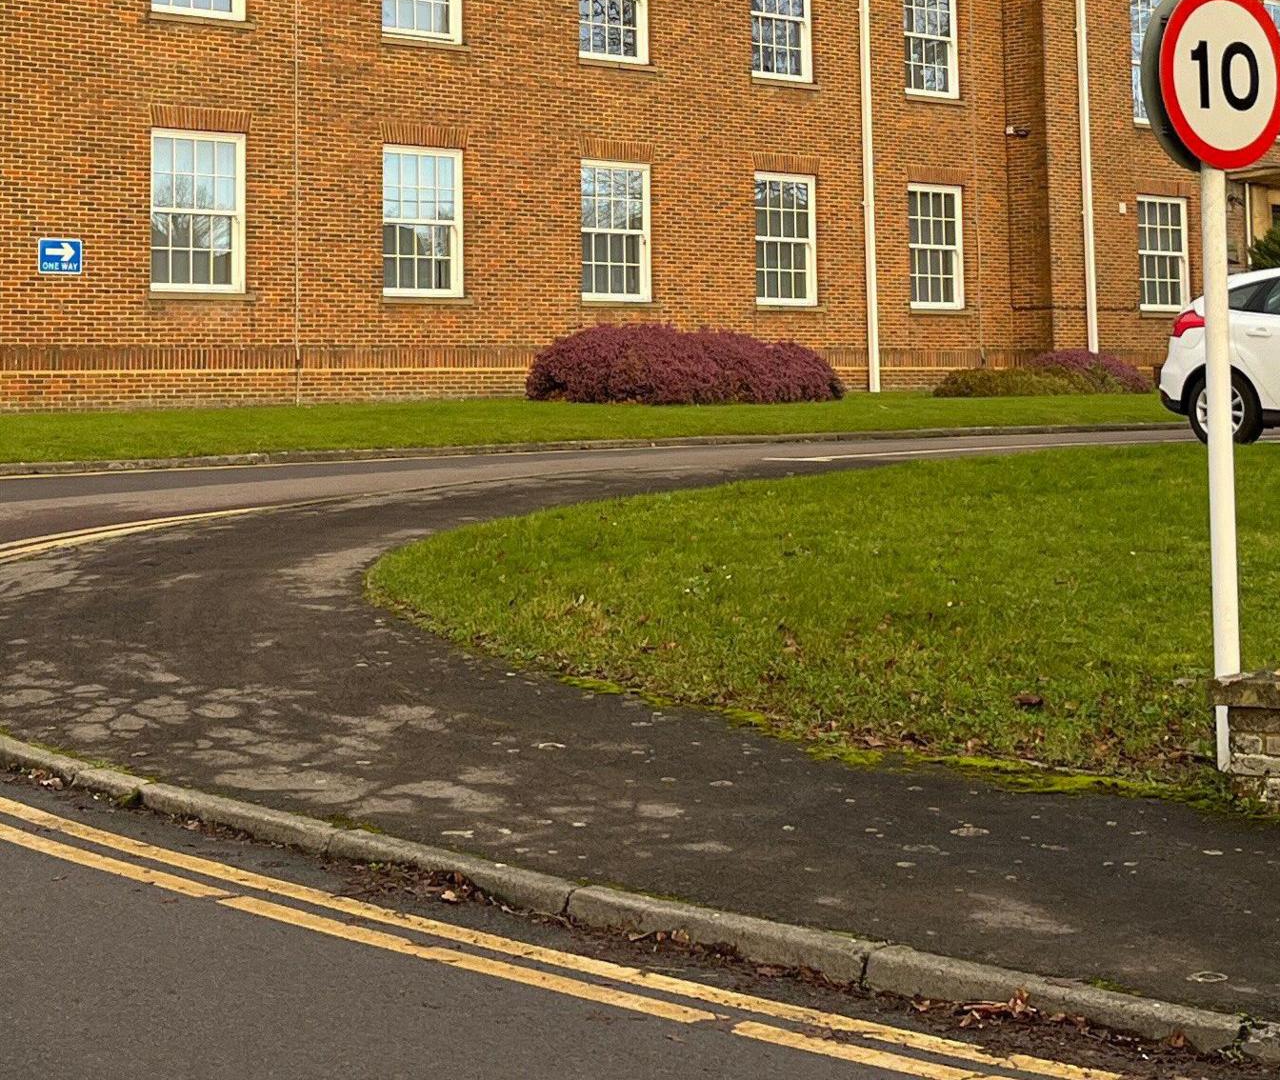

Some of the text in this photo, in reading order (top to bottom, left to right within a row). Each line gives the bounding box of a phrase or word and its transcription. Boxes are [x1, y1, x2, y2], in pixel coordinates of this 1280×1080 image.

[1190, 40, 1259, 111] 10
[43, 262, 78, 270] ONE WAY
